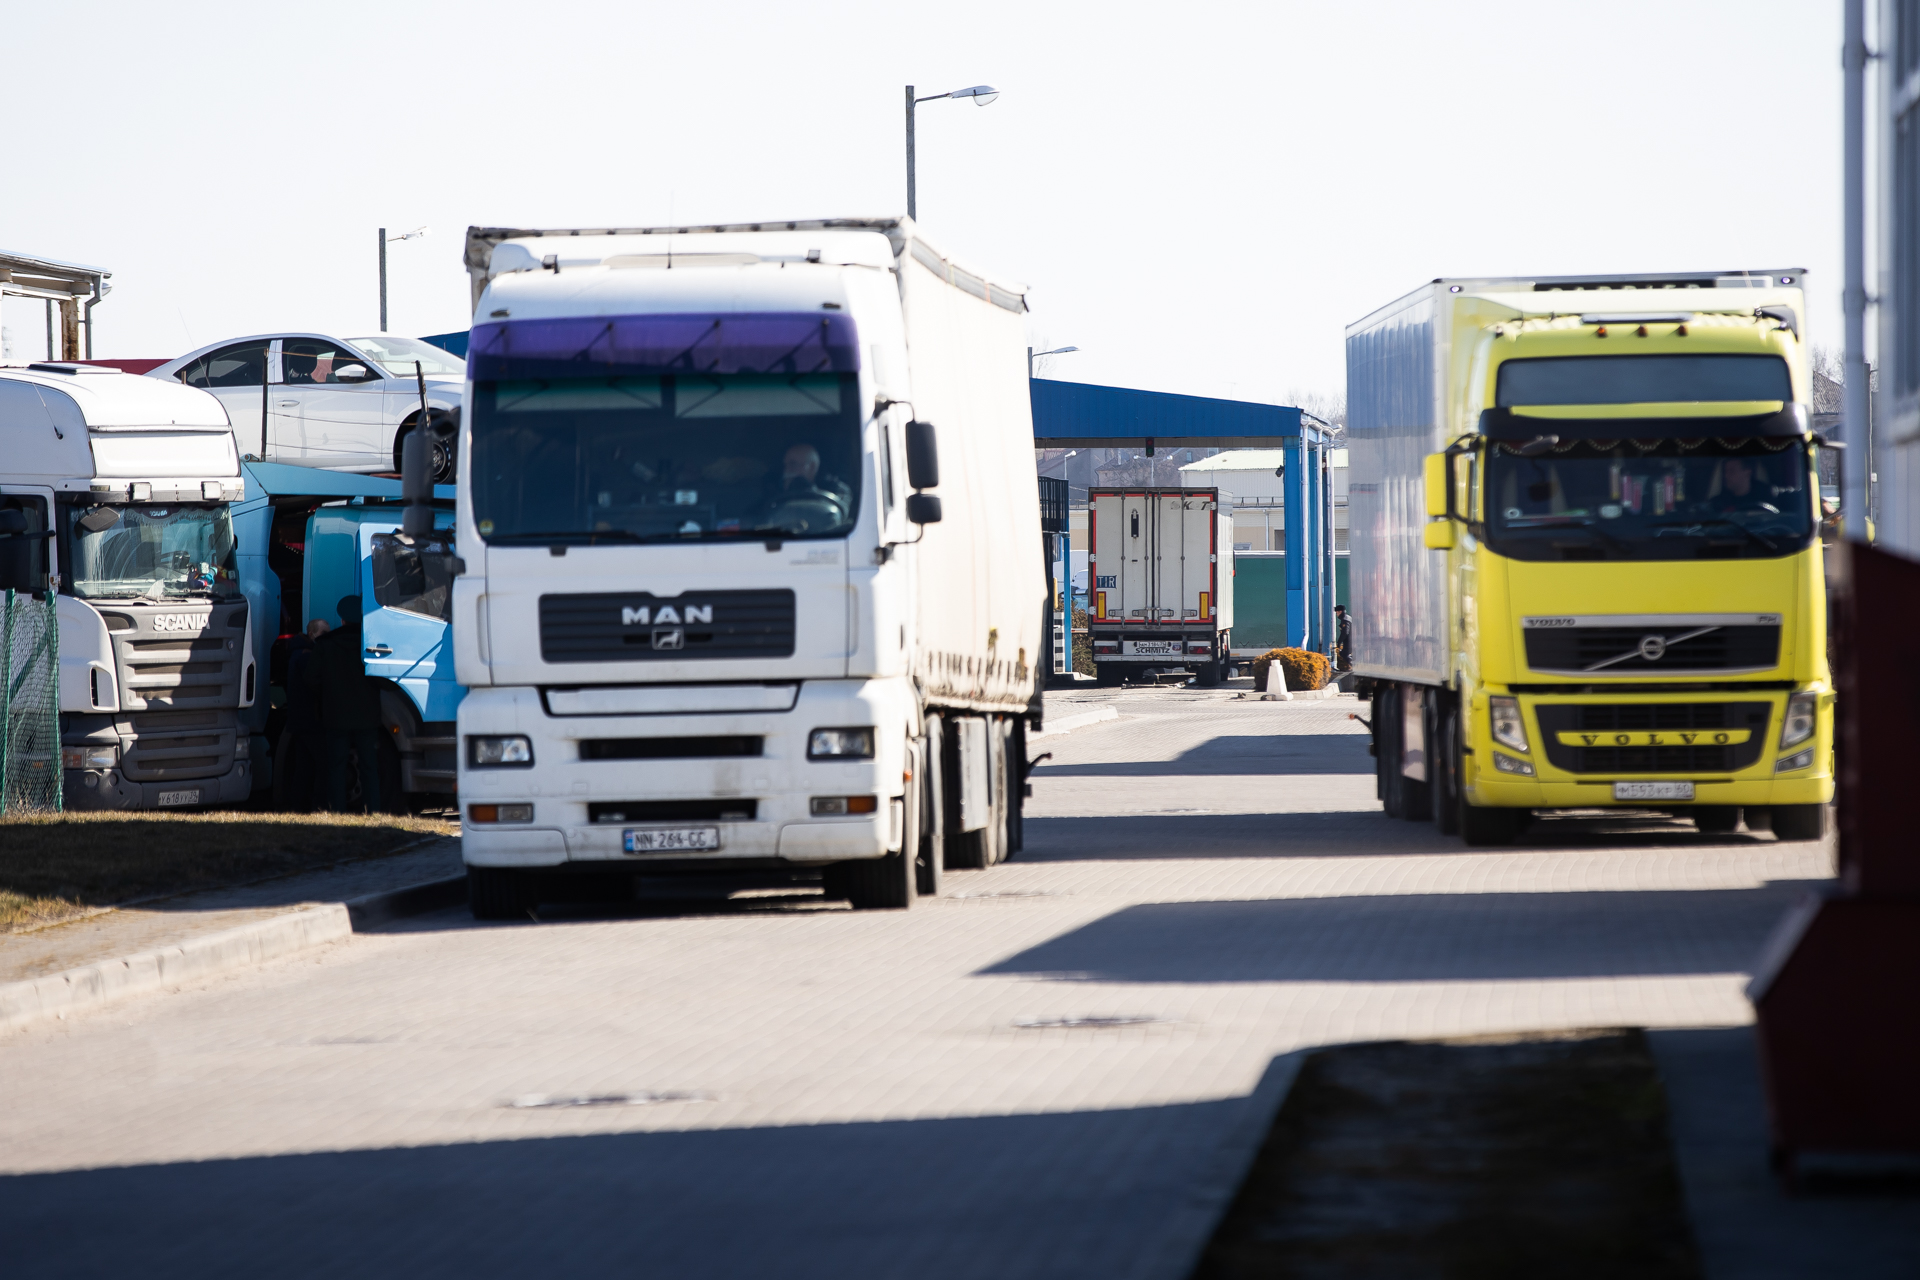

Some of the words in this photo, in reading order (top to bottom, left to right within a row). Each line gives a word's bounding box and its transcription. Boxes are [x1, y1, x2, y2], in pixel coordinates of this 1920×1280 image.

[1097, 576, 1115, 588] TIR
[153, 613, 210, 631] SCANIA
[622, 604, 713, 625] MAN
[1527, 618, 1576, 627] VOLVO
[1580, 732, 1730, 747] VOLVO
